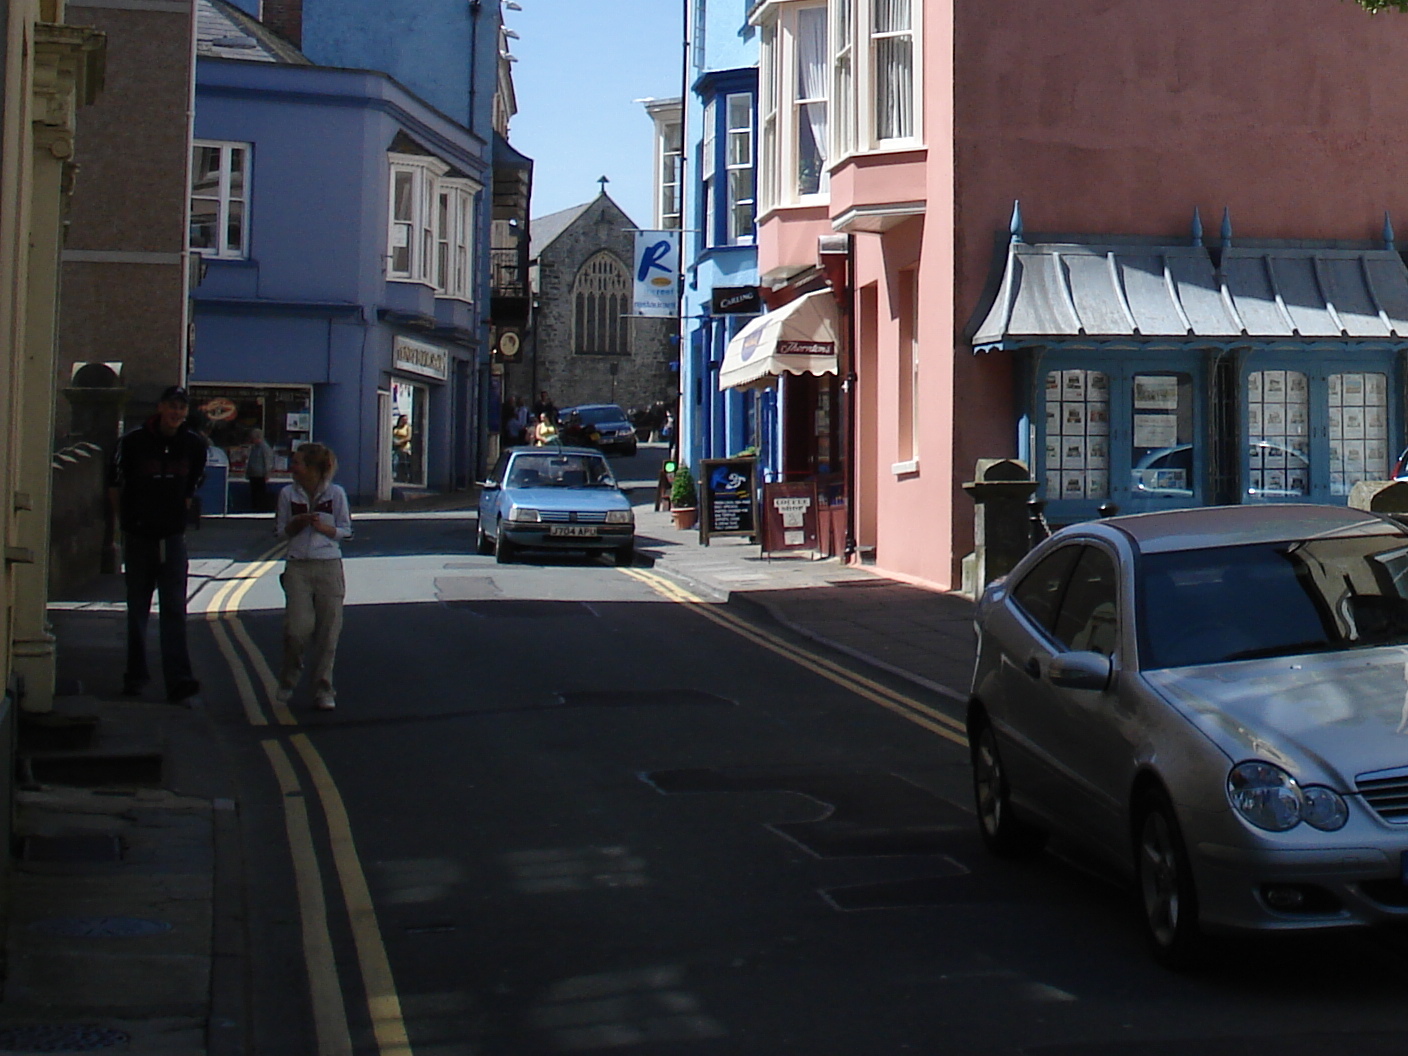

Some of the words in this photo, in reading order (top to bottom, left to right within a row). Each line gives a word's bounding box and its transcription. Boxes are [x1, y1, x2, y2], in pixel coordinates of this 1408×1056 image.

[637, 240, 673, 282] R
[780, 341, 832, 354] Thorntons
[552, 527, 576, 535] J704
